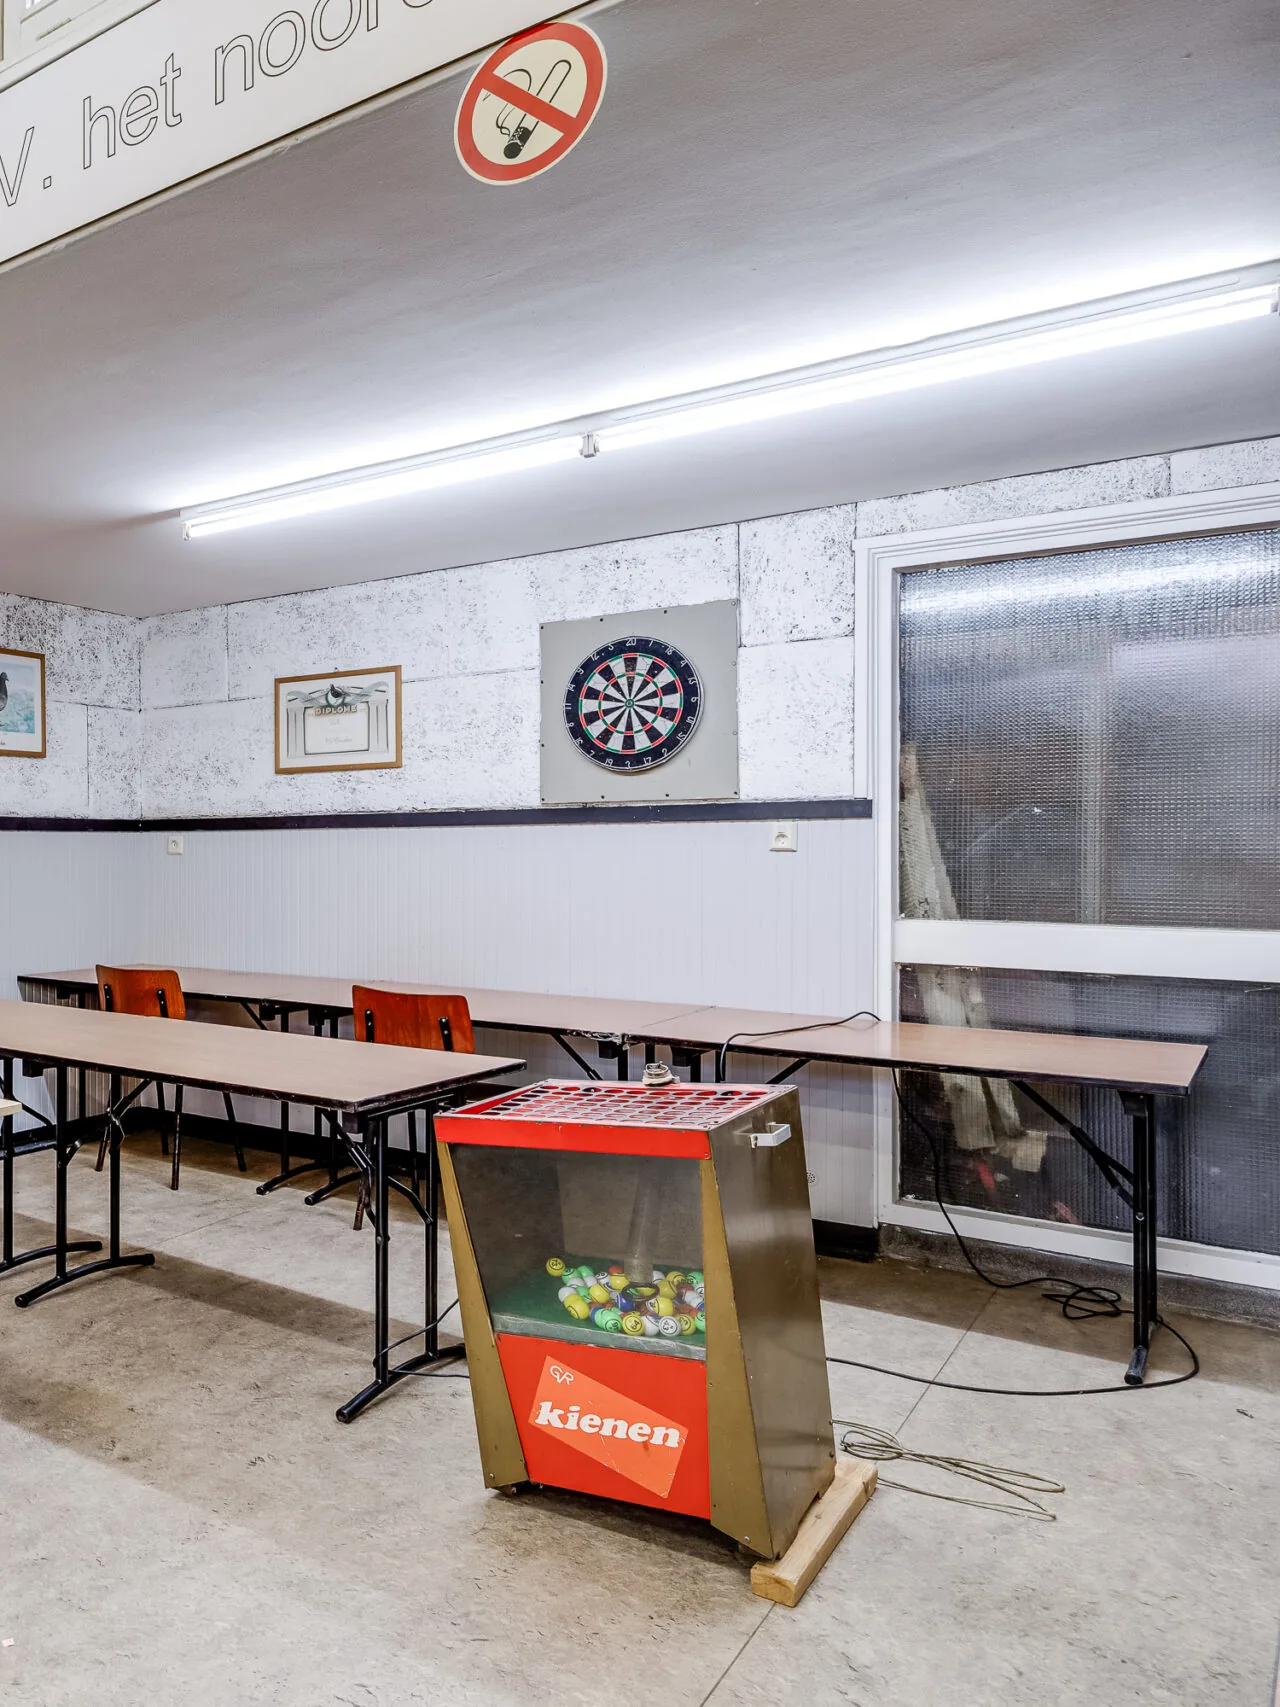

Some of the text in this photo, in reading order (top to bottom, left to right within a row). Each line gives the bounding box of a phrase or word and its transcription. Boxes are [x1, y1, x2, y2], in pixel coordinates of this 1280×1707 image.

[83, 53, 182, 169] het
[215, 0, 433, 105] noo
[625, 638, 637, 646] 20
[590, 652, 600, 661] 12
[680, 659, 687, 667] 4
[314, 704, 358, 717] DIPLOME
[676, 732, 686, 741] 15
[661, 748, 668, 757] 2
[605, 758, 614, 767] 19
[625, 760, 631, 769] 3
[643, 757, 652, 765] 17
[535, 1401, 680, 1448] kienen
